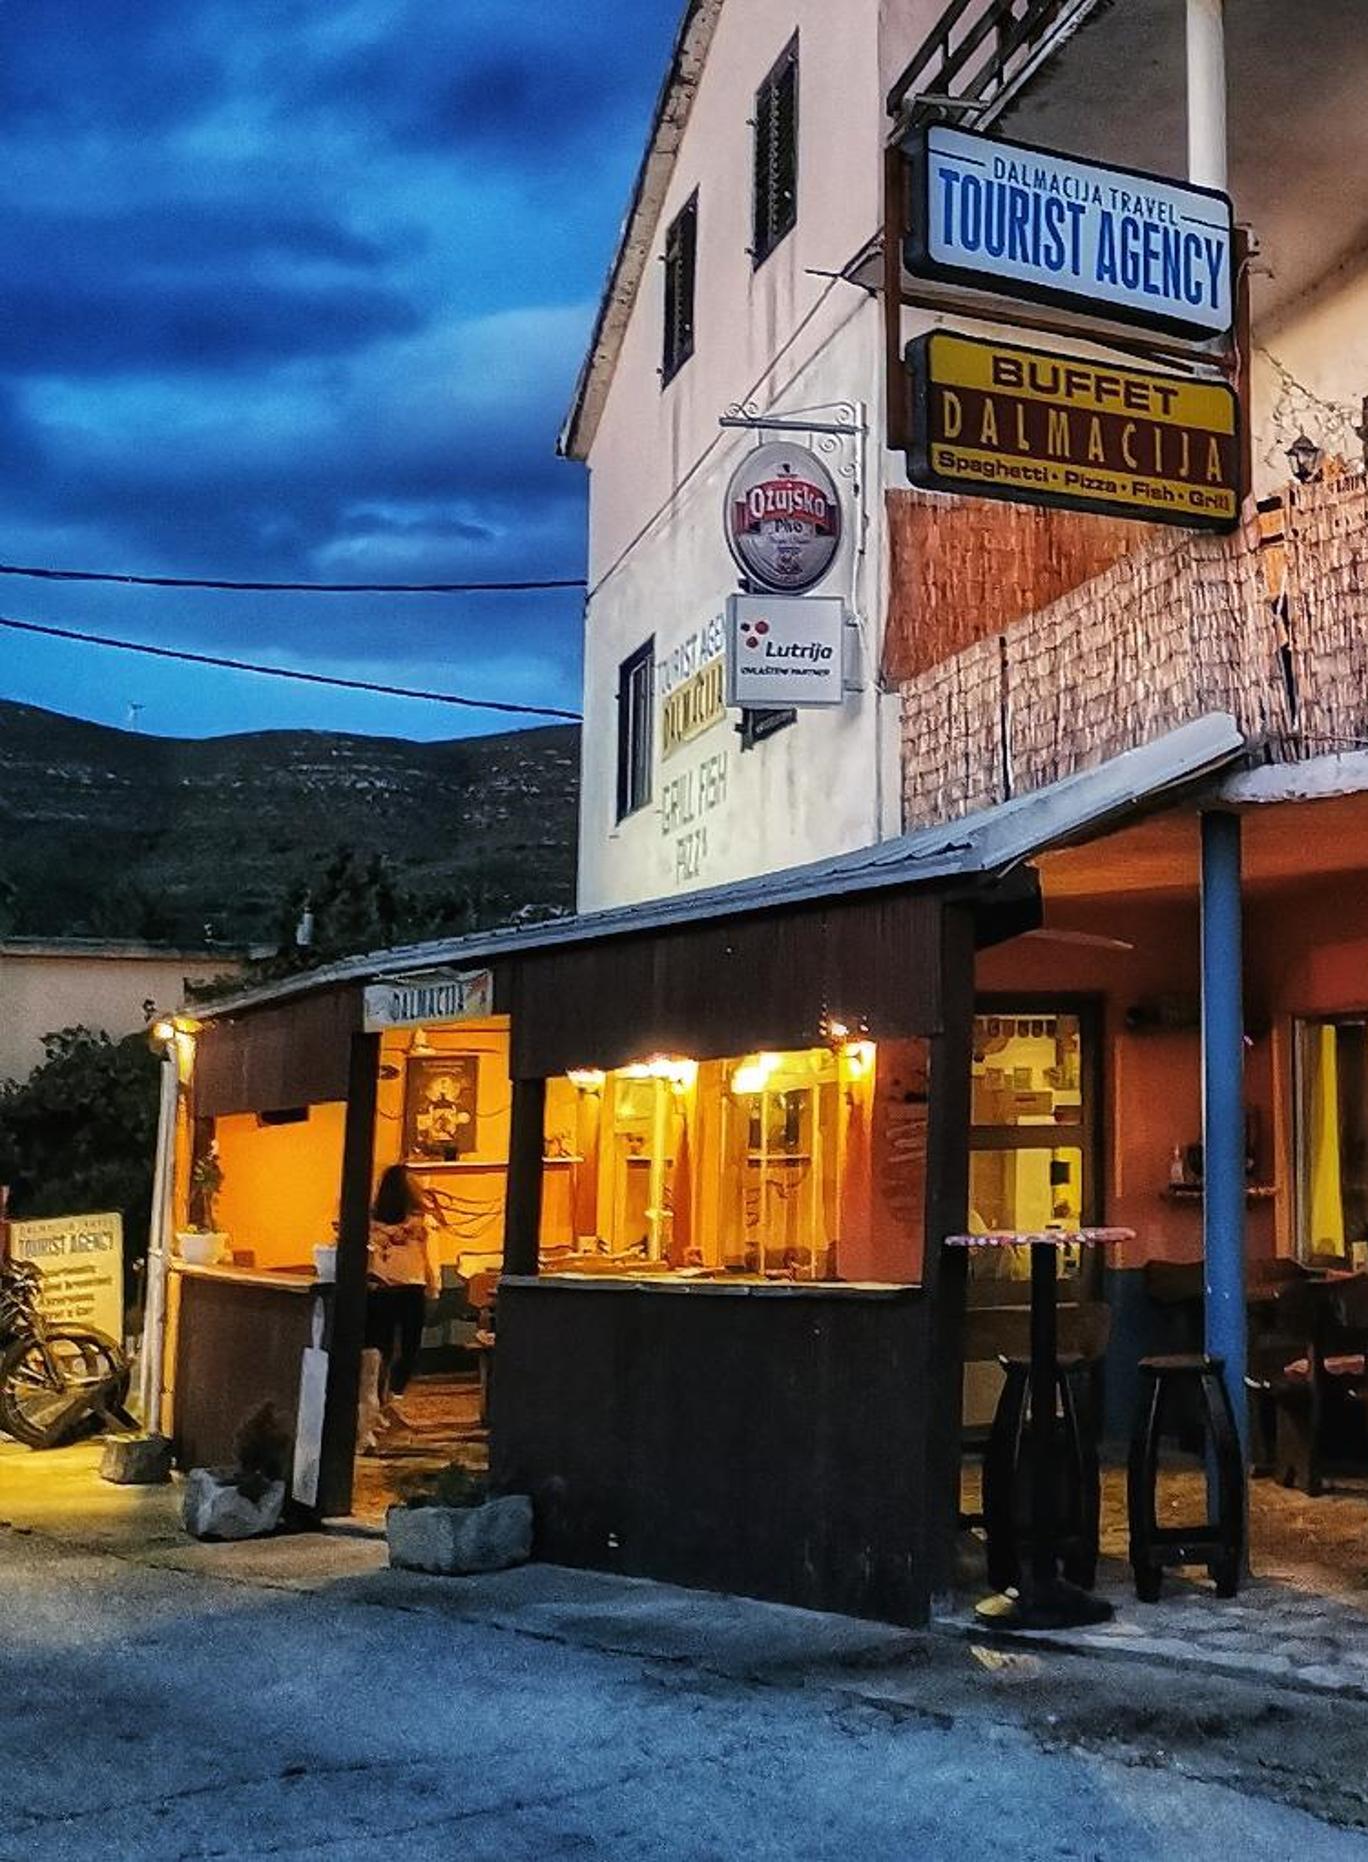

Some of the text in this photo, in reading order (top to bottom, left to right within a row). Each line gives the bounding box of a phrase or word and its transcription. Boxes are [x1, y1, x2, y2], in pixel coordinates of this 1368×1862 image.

[993, 157, 1178, 225] DALMACIJA TRAVEL
[938, 167, 1225, 309] TOURIST AGENCY
[992, 354, 1180, 416] BUFFET
[943, 390, 1225, 483] DALMACIJA
[937, 450, 1231, 512] Spaghetti Pizza Fish Grill
[765, 641, 833, 662] Lutrija
